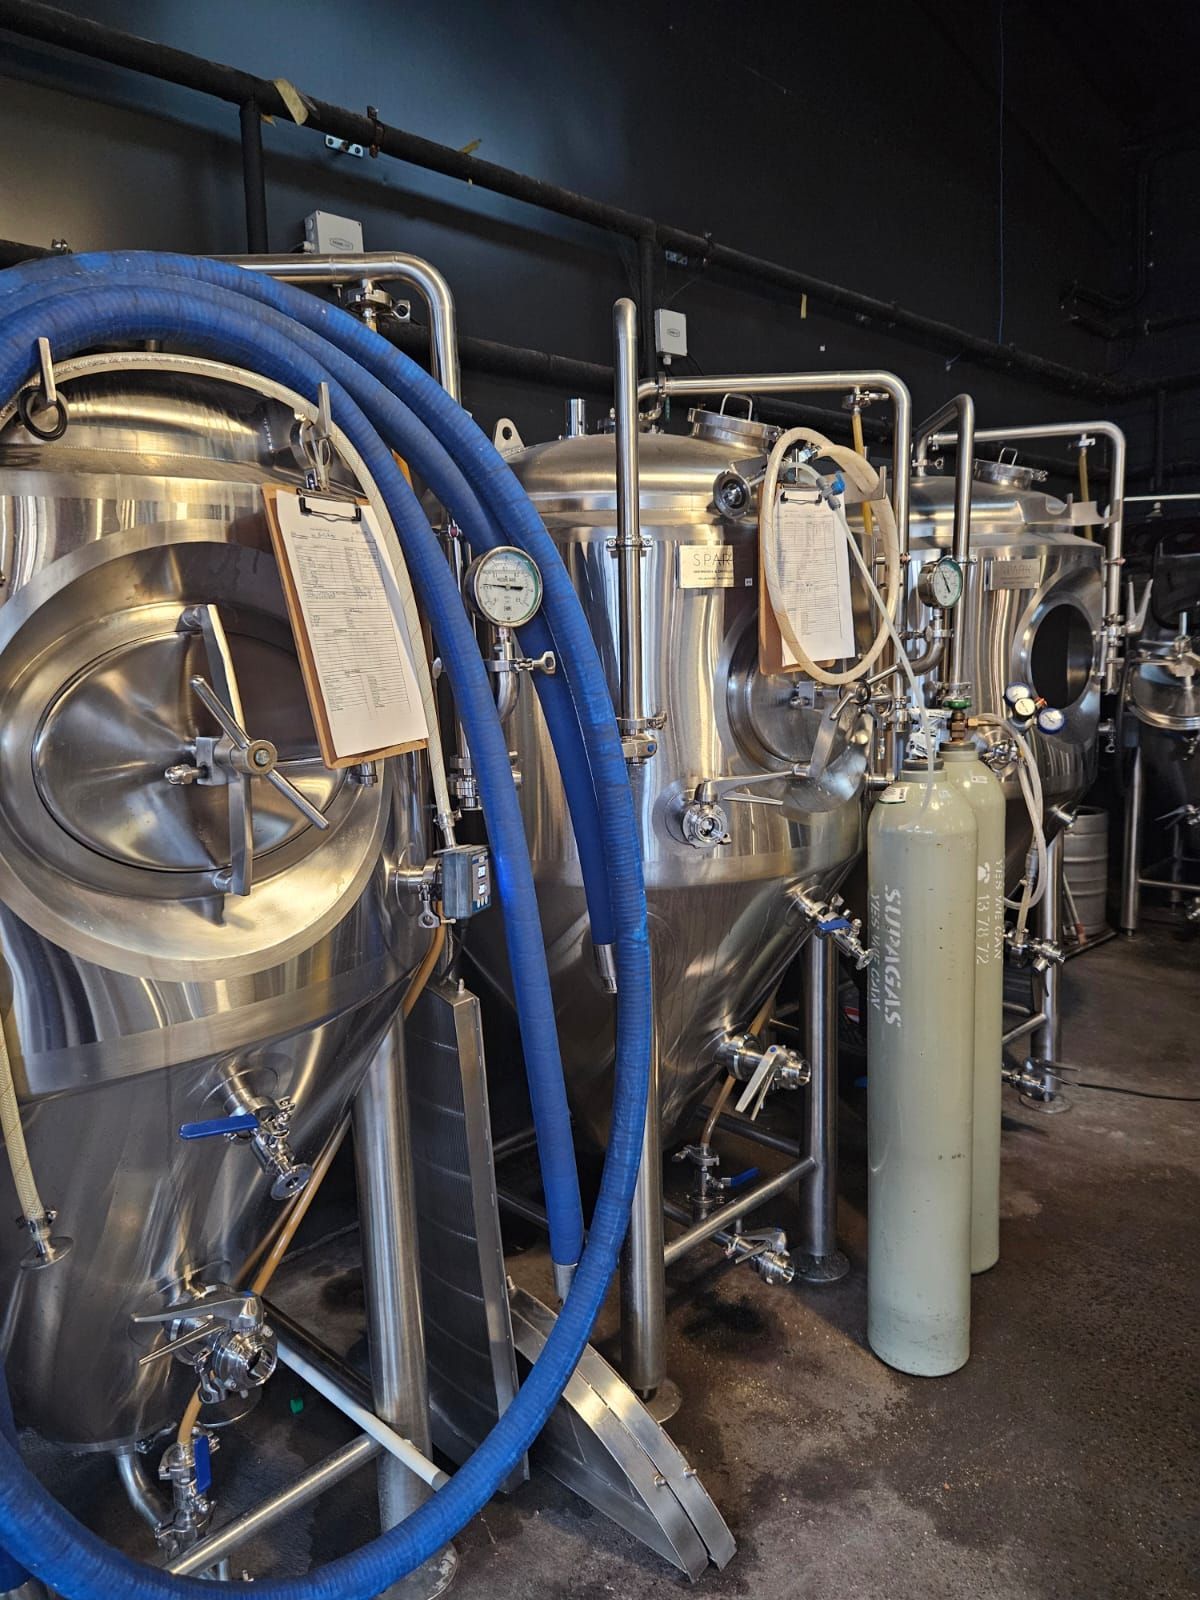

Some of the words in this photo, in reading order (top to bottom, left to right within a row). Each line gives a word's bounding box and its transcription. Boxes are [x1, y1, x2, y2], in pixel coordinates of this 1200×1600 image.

[693, 553, 733, 567] SPAR
[994, 860, 1003, 890] YES
[871, 894, 880, 930] YES
[976, 895, 990, 912] 13
[994, 896, 1003, 921] WE
[884, 885, 901, 1028] SUPAGAS
[994, 926, 1003, 960] CAN
